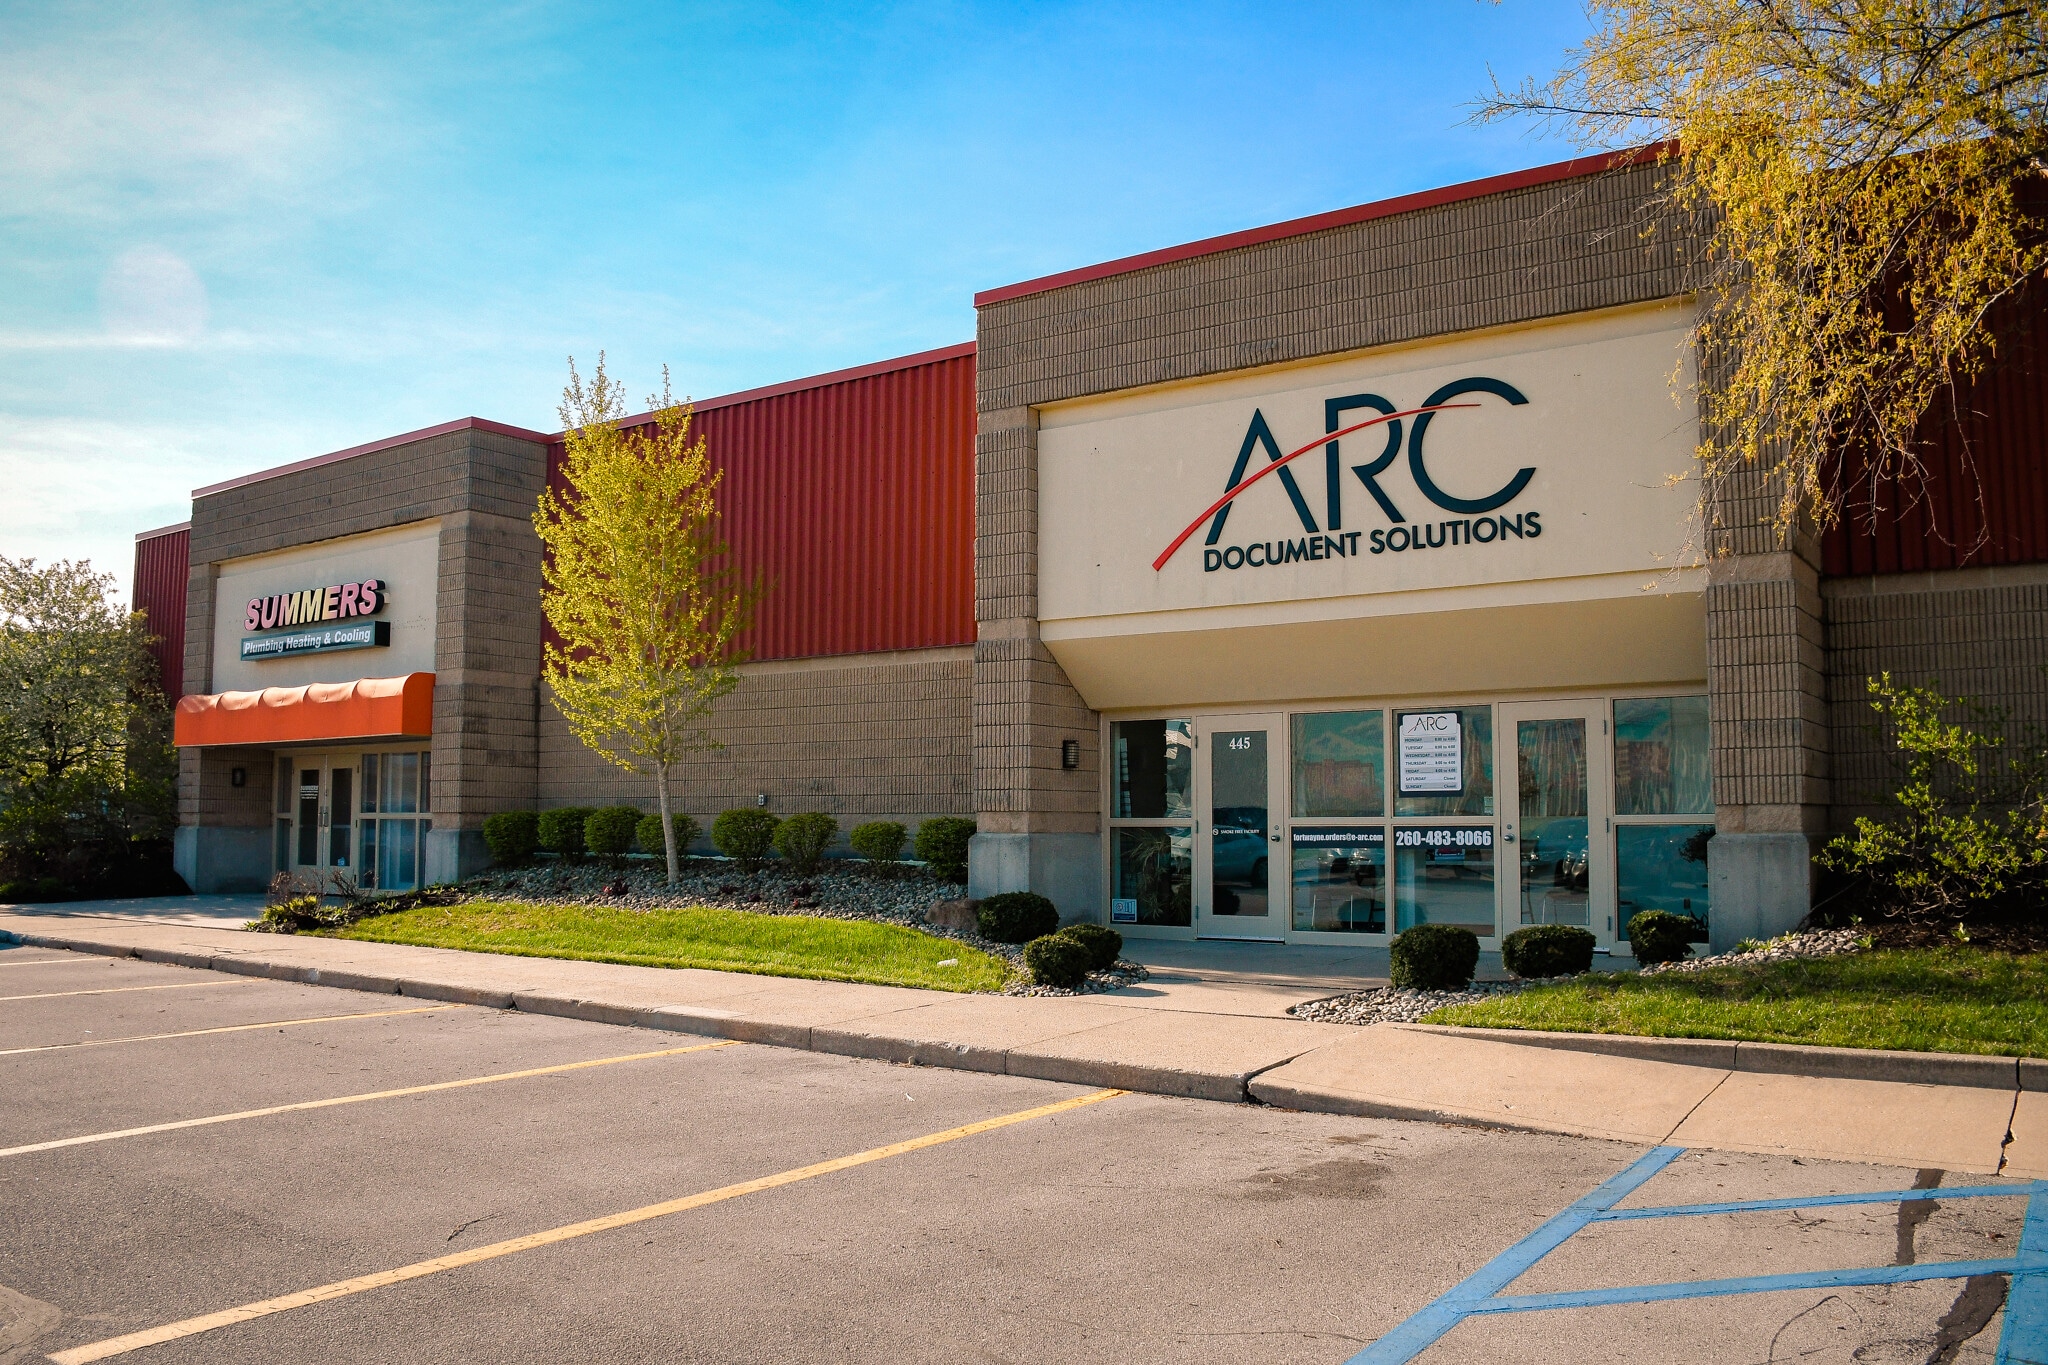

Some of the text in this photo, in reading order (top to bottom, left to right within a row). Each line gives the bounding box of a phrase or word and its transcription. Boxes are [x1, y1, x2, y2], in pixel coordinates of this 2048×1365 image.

[1205, 377, 1537, 545] ARC
[1204, 511, 1542, 572] DOCUMENT SOLUTIONS
[243, 578, 380, 631] SUMMERS
[243, 628, 372, 655] Plumbing Heating & Cooling
[1414, 716, 1448, 731] ARC
[1229, 737, 1251, 750] 445
[1294, 833, 1383, 842] fortwayne.orders@e-arc.com
[1395, 830, 1492, 846] 260-483-8066
